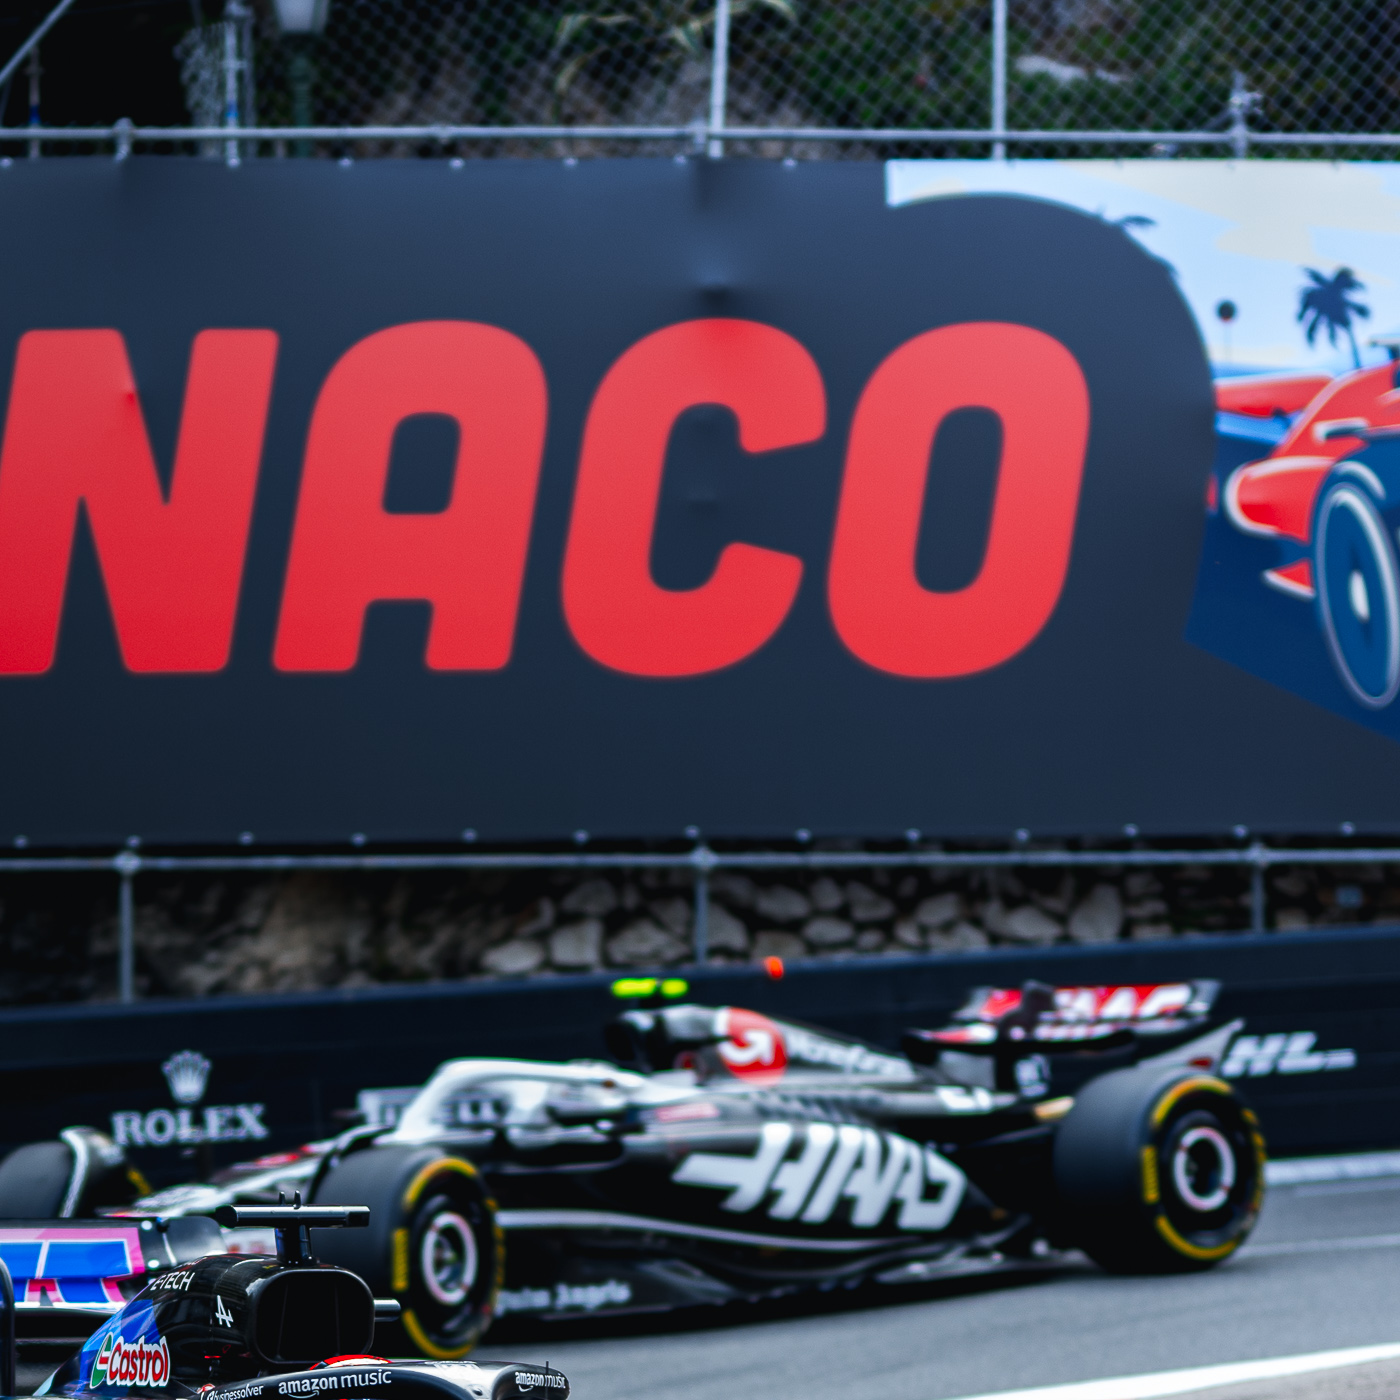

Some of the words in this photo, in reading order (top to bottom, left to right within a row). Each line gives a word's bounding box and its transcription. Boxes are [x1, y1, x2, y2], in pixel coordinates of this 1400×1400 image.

[1221, 1031, 1329, 1077] HL
[112, 1104, 268, 1146] ROLEX
[107, 1336, 170, 1387] Castrol
[278, 1375, 338, 1396] amazon
[341, 1368, 392, 1388] music
[515, 1371, 544, 1386] amazon
